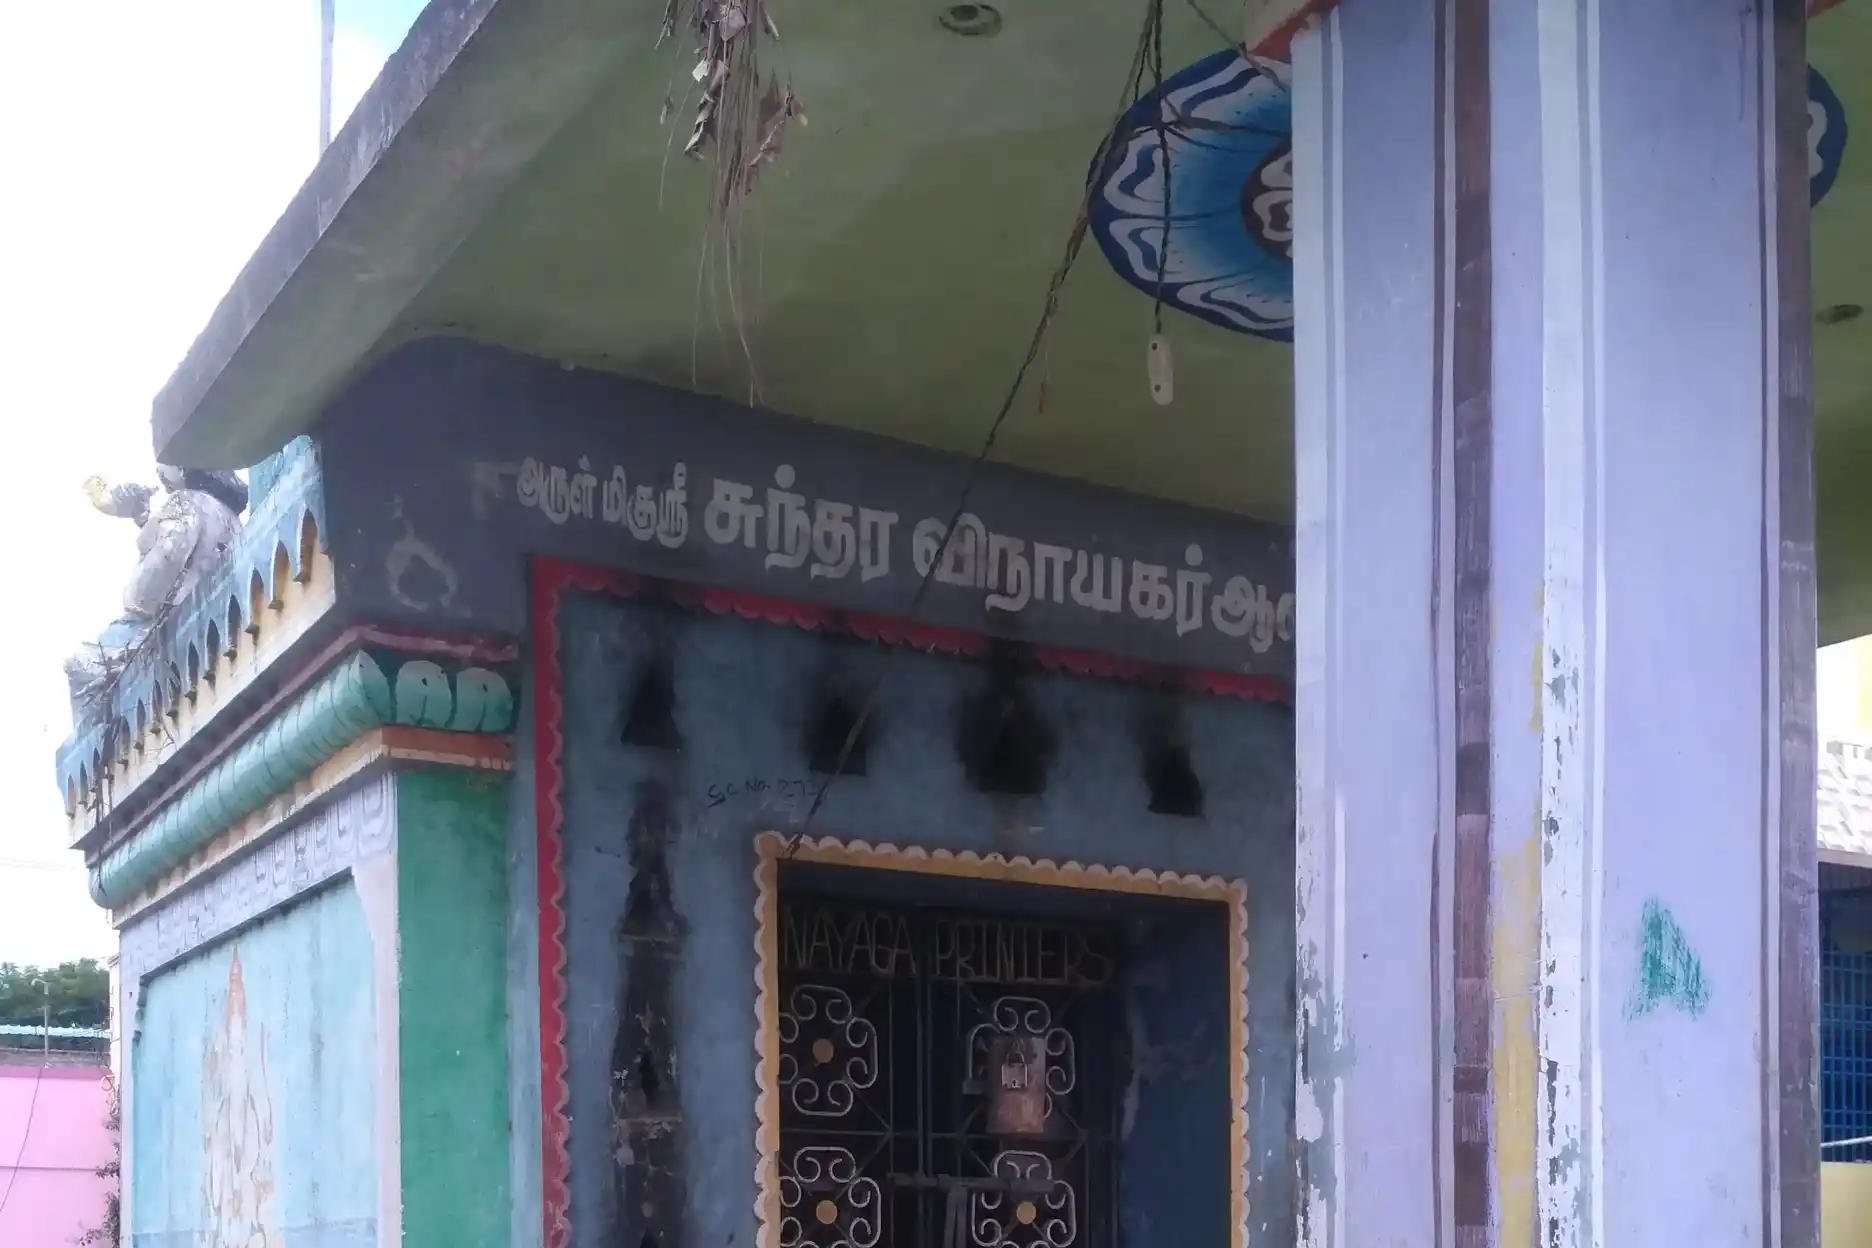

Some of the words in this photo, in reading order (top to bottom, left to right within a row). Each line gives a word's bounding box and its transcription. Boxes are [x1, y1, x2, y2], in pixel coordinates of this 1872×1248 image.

[704, 464, 900, 584] சுந்தர
[912, 512, 1213, 637] விநாயகர்
[784, 905, 917, 975] NAYAGA
